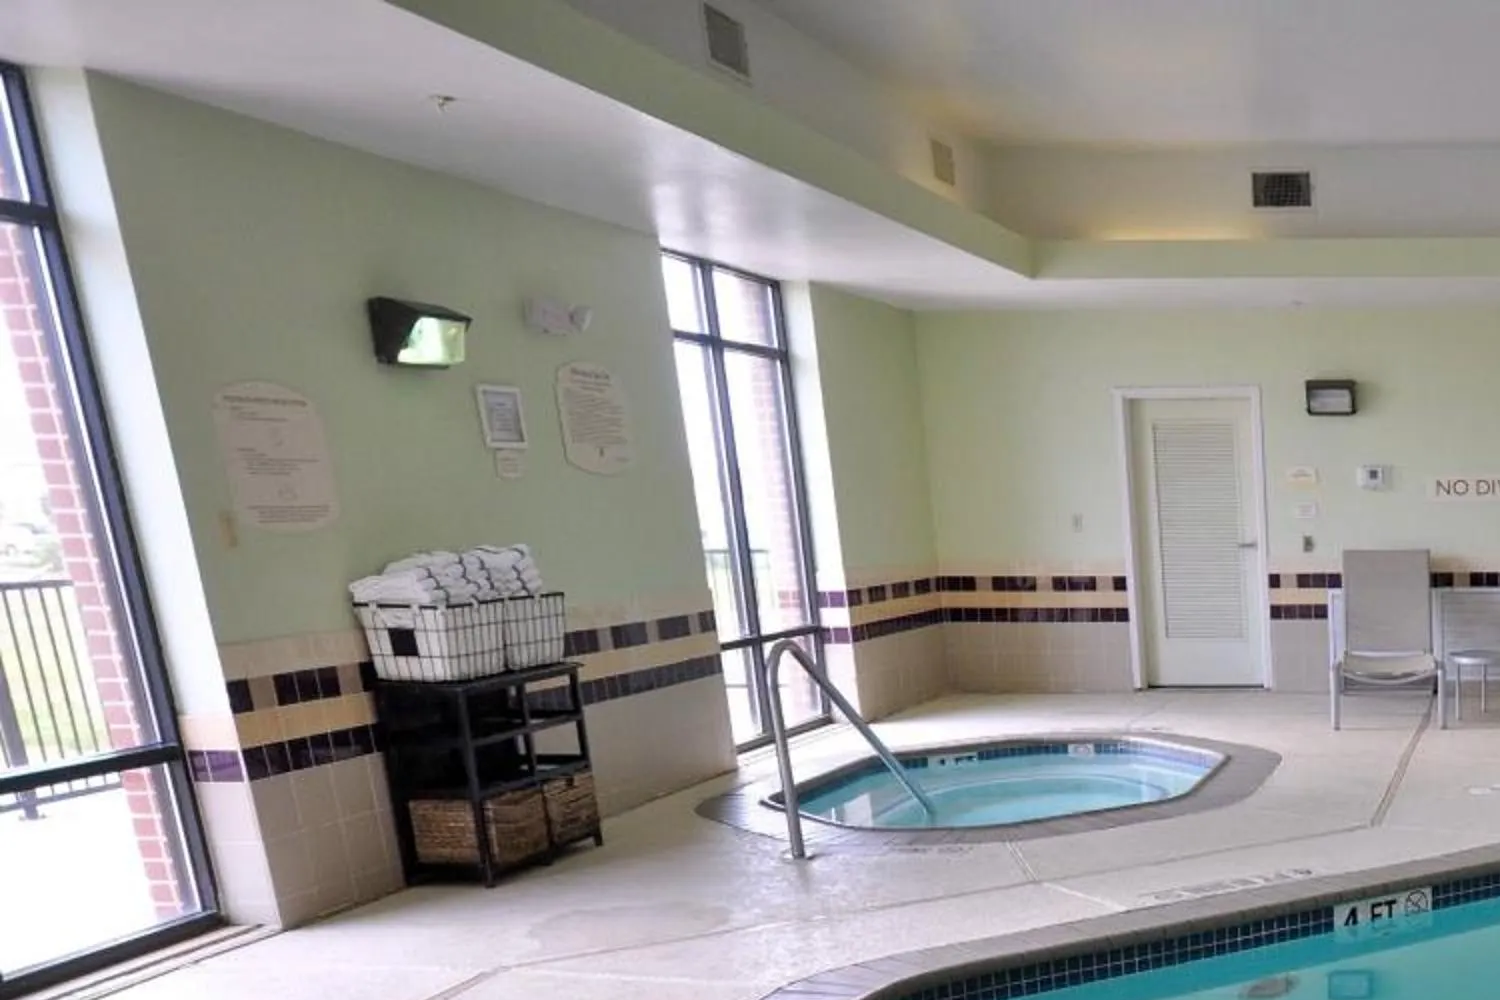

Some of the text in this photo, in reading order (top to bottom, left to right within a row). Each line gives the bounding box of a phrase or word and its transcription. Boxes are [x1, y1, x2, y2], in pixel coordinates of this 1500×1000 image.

[1435, 478, 1469, 496] NO
[1344, 900, 1397, 927] 4 FT
